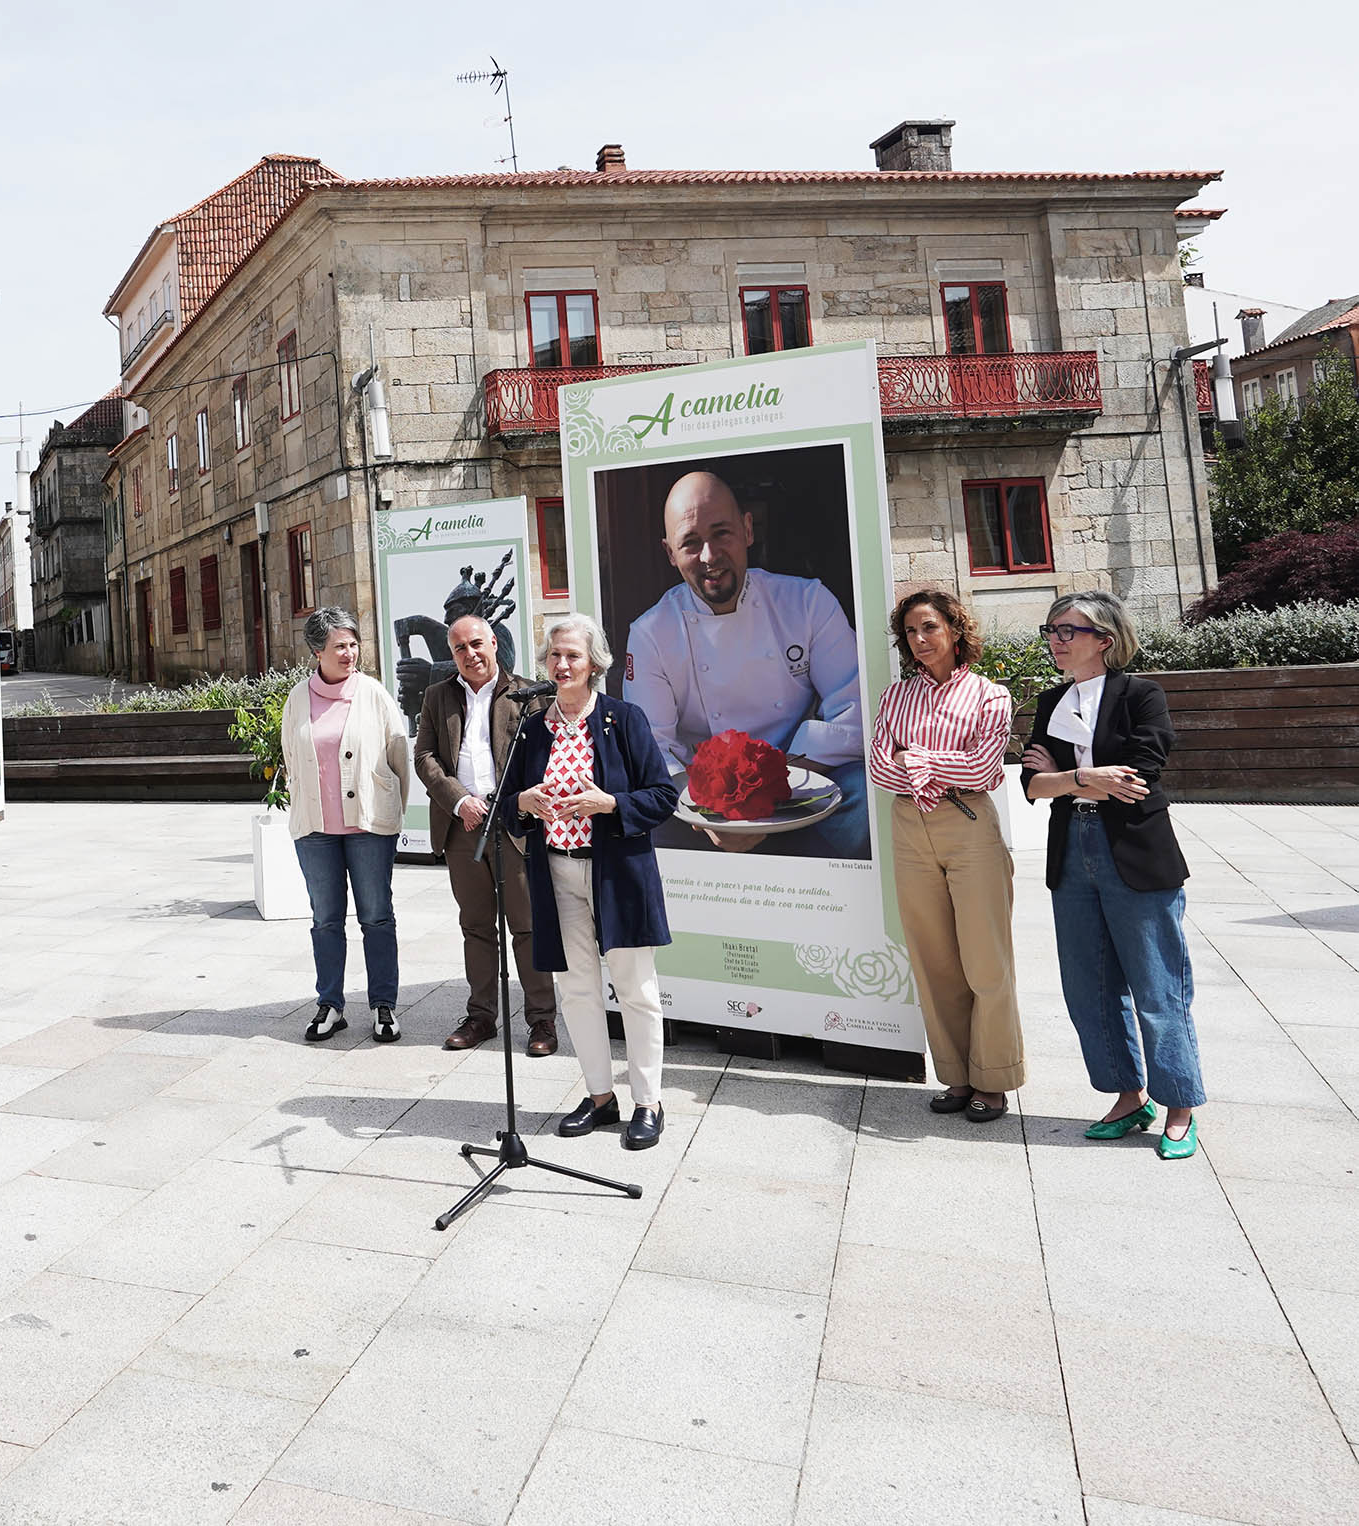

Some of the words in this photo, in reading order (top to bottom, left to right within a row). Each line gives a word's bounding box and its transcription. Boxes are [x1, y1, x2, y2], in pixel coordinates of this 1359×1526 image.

[627, 392, 675, 440] A
[680, 382, 784, 418] camelia
[408, 517, 433, 541] A
[435, 514, 485, 531] camelia
[665, 878, 694, 888] camelia
[703, 880, 714, 889] un
[742, 882, 762, 894] para
[764, 883, 785, 894] todos
[787, 886, 796, 895] os
[690, 892, 738, 906] pretendemos
[754, 898, 760, 907] a
[794, 902, 814, 911] nosa
[727, 999, 746, 1012] SEC
[845, 1017, 900, 1028] INTERNATIONAL
[845, 1023, 874, 1032] CAMELLIA
[877, 1026, 901, 1034] SOCIETY
